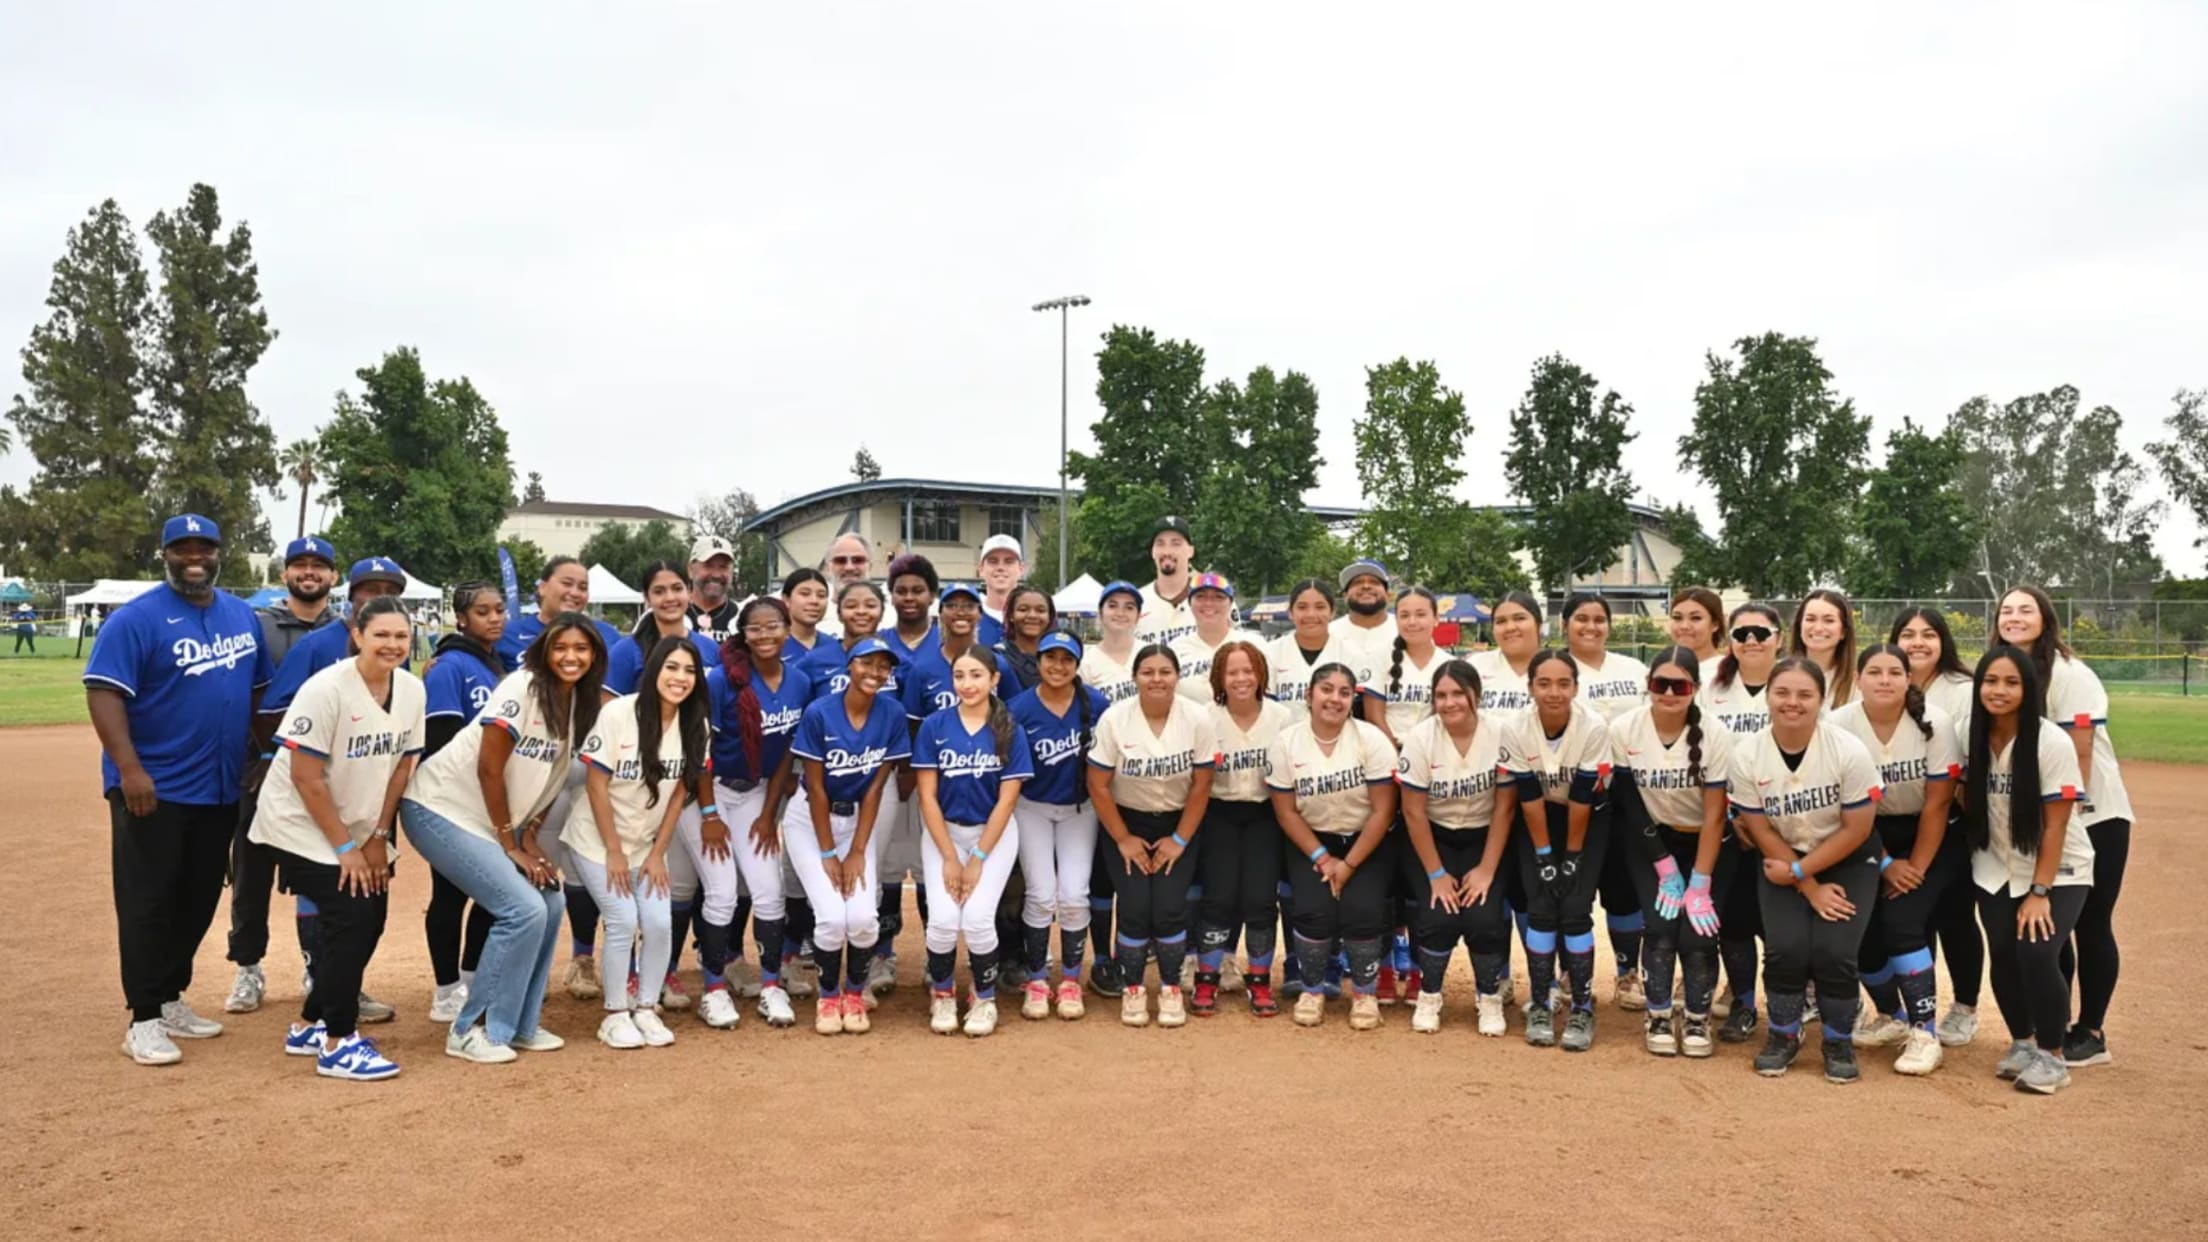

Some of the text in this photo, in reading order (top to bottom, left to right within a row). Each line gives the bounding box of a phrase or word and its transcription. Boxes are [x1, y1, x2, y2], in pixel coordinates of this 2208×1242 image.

[173, 632, 258, 676] Dodgers
[1588, 680, 1638, 699] ANGELES
[346, 734, 371, 758] LOS
[1232, 748, 1267, 770] ANGEL
[1122, 758, 1143, 777] LOS
[1145, 749, 1195, 777] ANGELES
[1876, 757, 1927, 785] NGELES
[1294, 765, 1366, 797] LOS ANGELES
[1451, 769, 1497, 798] ANGELE
[1632, 768, 1647, 788] OS
[1765, 783, 1840, 817] OS ANGELES
